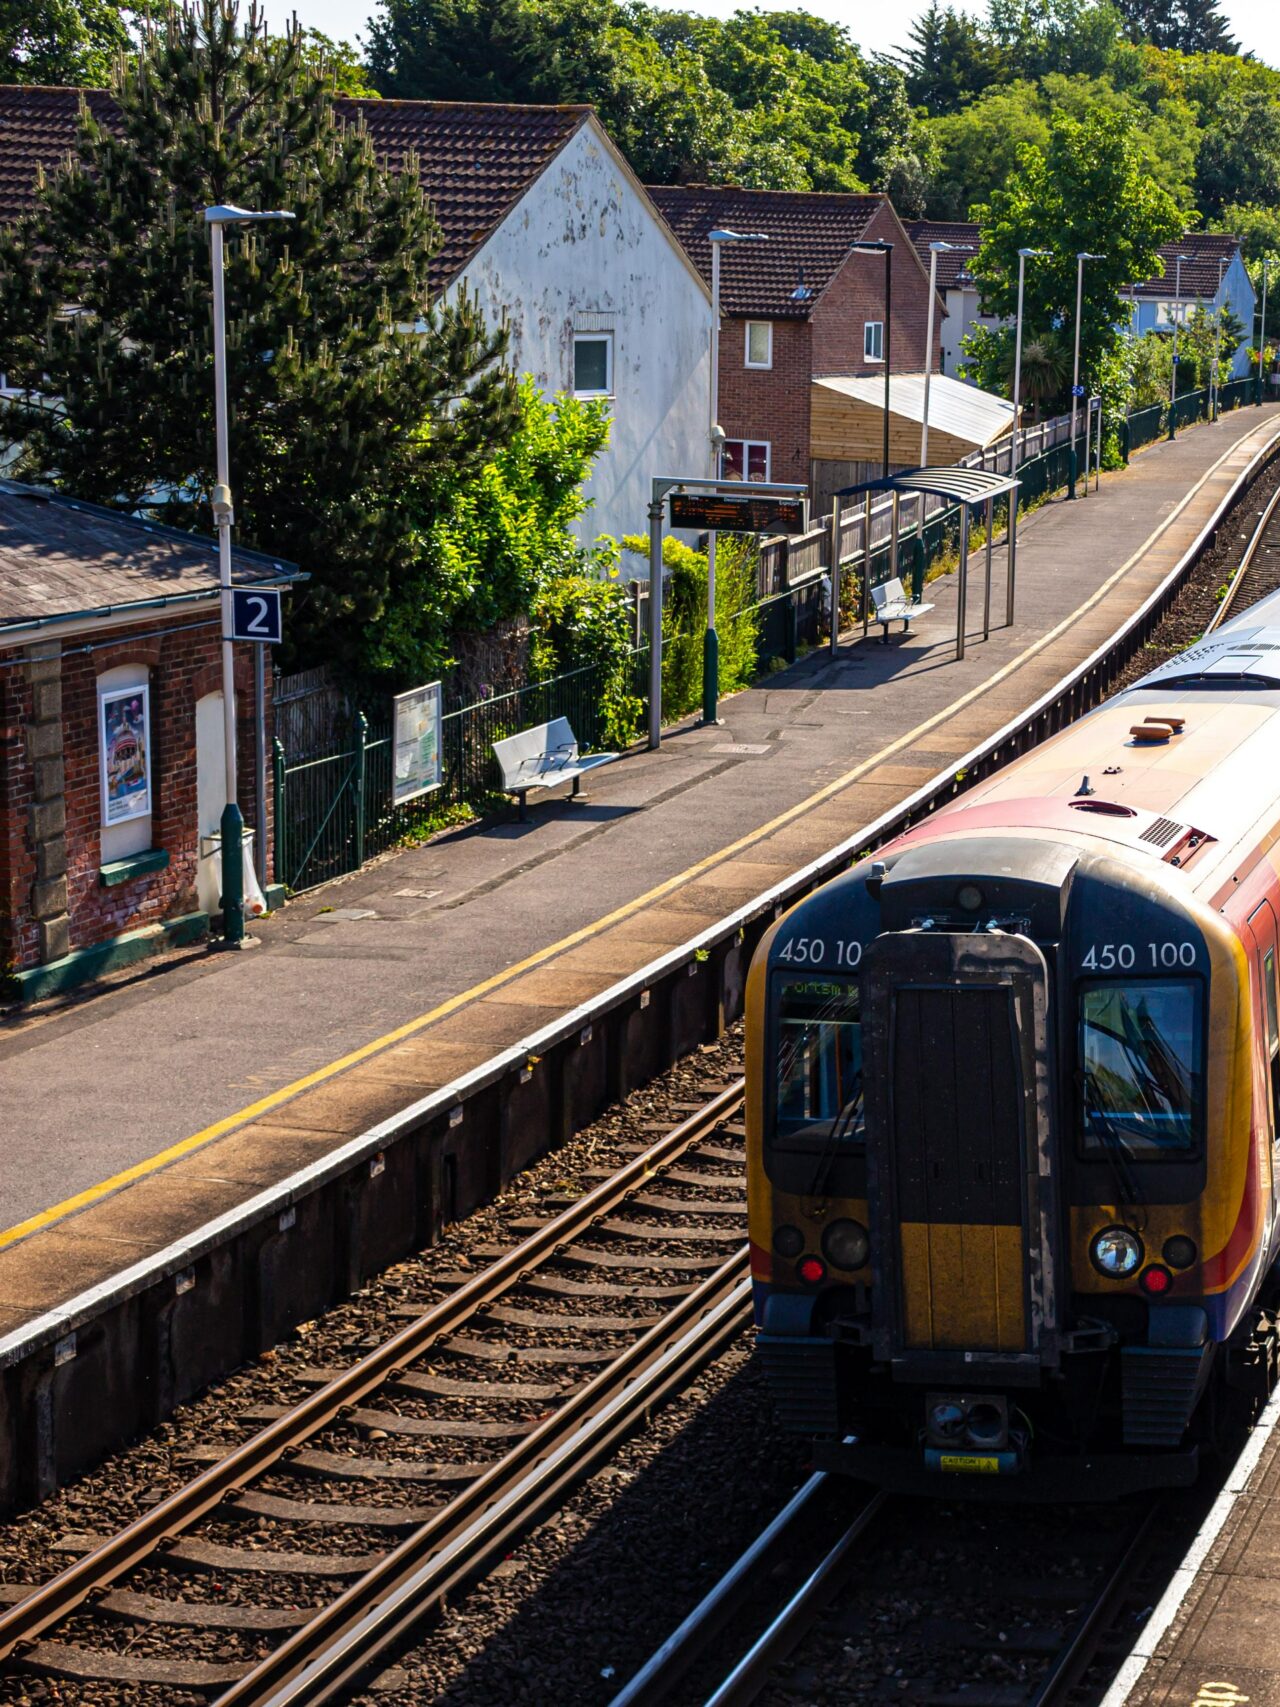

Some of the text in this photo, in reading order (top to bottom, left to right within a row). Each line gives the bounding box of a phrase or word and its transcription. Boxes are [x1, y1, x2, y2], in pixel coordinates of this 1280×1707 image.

[1072, 385, 1084, 394] 2-3
[246, 596, 269, 633] 2
[778, 937, 863, 966] 450 10
[1081, 942, 1197, 970] 450 100
